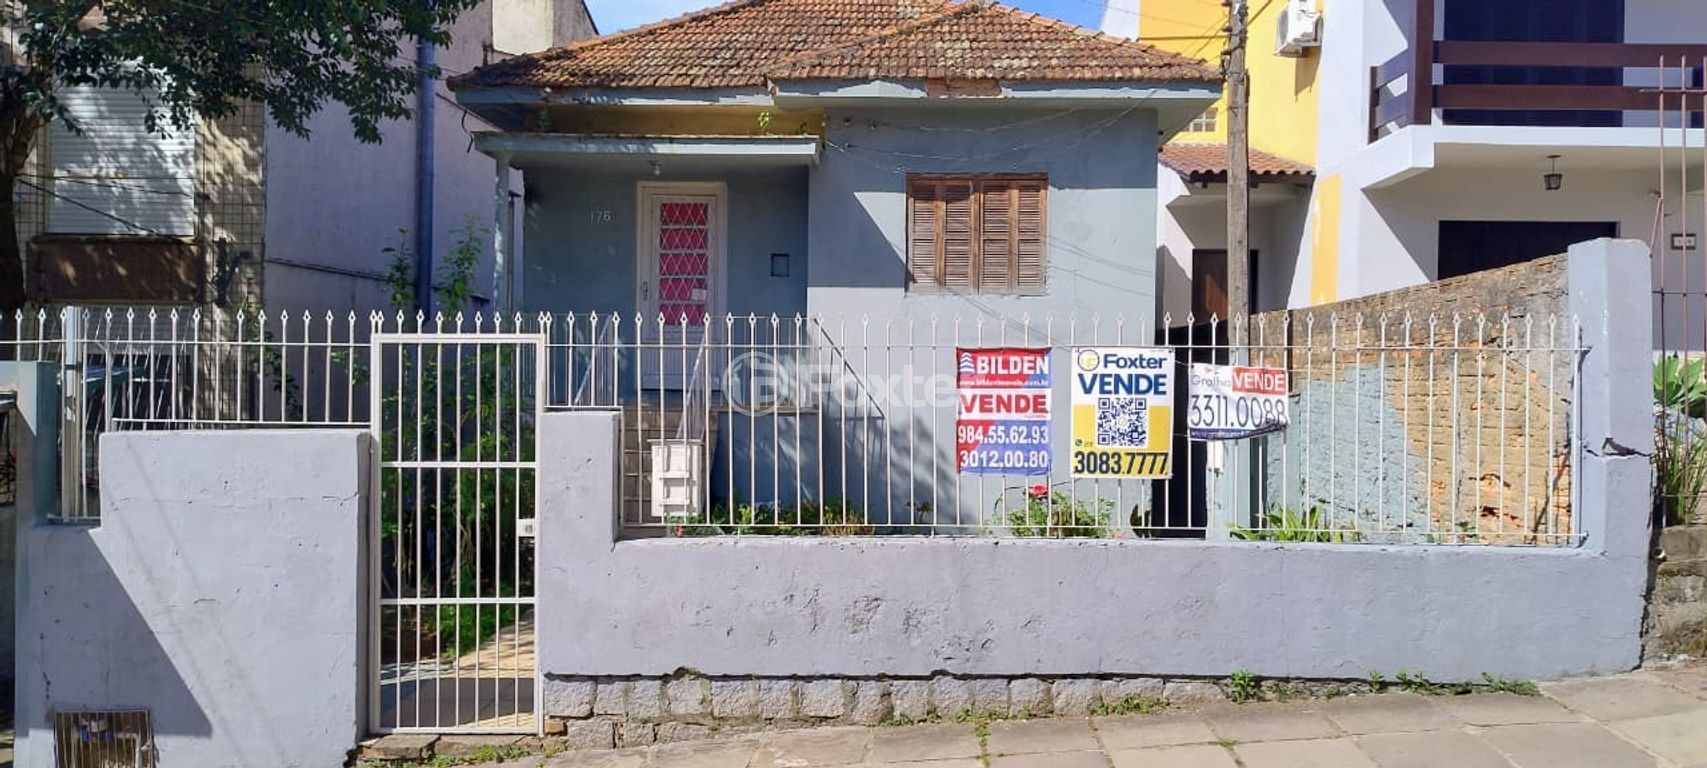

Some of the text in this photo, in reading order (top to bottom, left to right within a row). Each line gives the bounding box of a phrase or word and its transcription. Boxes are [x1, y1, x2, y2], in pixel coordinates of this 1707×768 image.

[590, 210, 611, 225] 176
[976, 355, 1049, 375] BILDEN
[1103, 353, 1168, 369] Foxter
[1077, 373, 1168, 396] VENDE
[1191, 374, 1231, 387] Gralha
[1232, 371, 1286, 392] VENDE
[960, 393, 1047, 414] VENDE
[1190, 394, 1288, 428] 3311.0088
[957, 425, 1049, 444] 984.55.62.93
[959, 450, 1048, 468] 3012.00.80
[1073, 450, 1169, 475] 3083.7777
